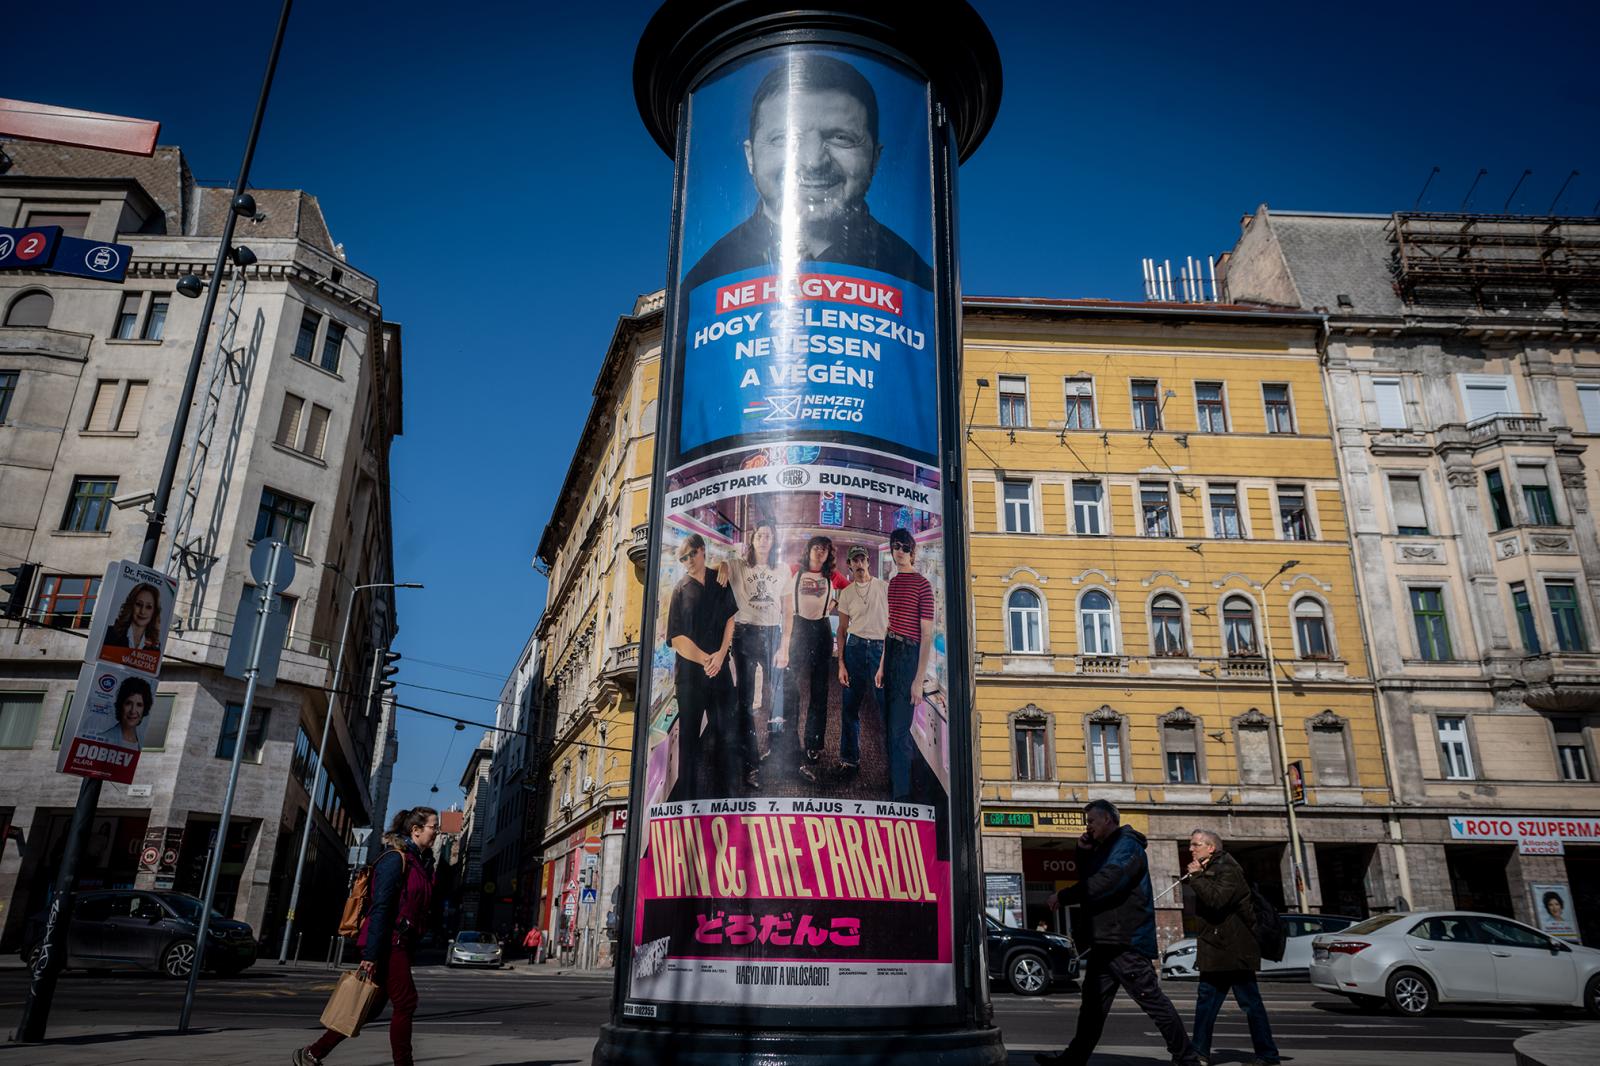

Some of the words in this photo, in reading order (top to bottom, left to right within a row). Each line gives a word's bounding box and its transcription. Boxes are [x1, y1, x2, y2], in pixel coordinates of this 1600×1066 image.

[24, 239, 38, 253] 2
[722, 284, 756, 309] NE
[763, 278, 901, 315] HAGYJUK,
[693, 311, 763, 350] HOGY
[769, 308, 925, 351] ZELENSZKIJ
[735, 334, 881, 361] NEVESSEN
[739, 368, 761, 388] A
[769, 359, 875, 390] VÉGÉN!
[804, 394, 865, 408] NEMZETI
[800, 406, 864, 423] PETÍCIÓ
[783, 476, 803, 485] PARK
[124, 566, 135, 576] Dr.
[75, 743, 134, 767] DOBREV
[616, 810, 628, 820] FO
[650, 804, 683, 817] MÁJUS
[691, 803, 700, 814] 7.
[710, 800, 757, 813] MÁJUS
[768, 801, 779, 812] 7.
[792, 799, 843, 813] MÁJUS
[854, 803, 865, 814] 7.
[876, 803, 919, 818] MÁJUS
[927, 809, 935, 819] 7.
[1466, 820, 1513, 836] ROTO
[650, 818, 712, 897] IVAN
[711, 816, 747, 897] &
[741, 816, 813, 897] THE
[803, 816, 937, 901] PARAZOL
[1042, 860, 1077, 872] FOTO
[695, 910, 861, 946] どろだんご
[736, 965, 760, 985] HAGYD
[761, 966, 778, 985] KINT
[779, 966, 785, 985] A
[786, 965, 830, 986] VALÓSÁGOT!
